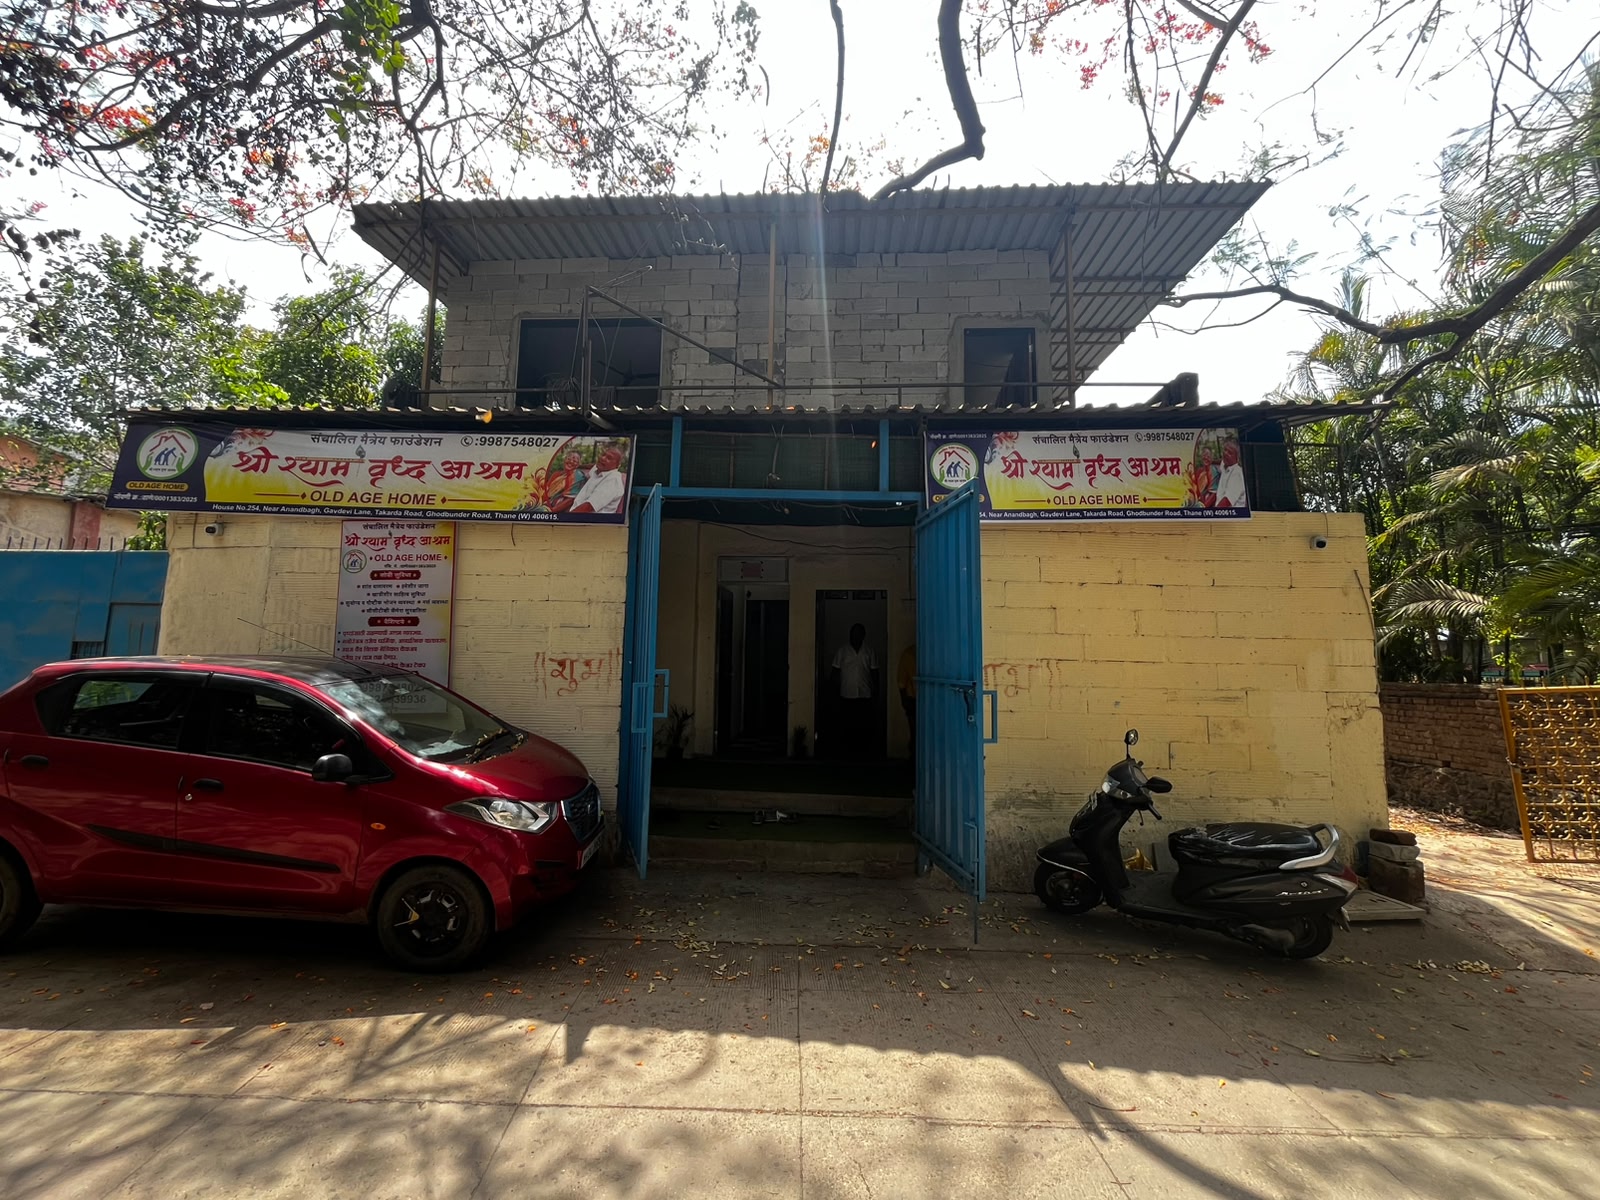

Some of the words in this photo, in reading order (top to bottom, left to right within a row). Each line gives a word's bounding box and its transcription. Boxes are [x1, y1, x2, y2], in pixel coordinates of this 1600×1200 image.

[311, 434, 358, 445] संचालित
[361, 433, 386, 446] मैत्रेय
[390, 434, 443, 447] फाउंडेशन
[1032, 434, 1066, 445] संचालित
[1090, 433, 1129, 444] फाउंडेशन
[310, 490, 344, 503] OLD
[348, 492, 383, 504] AGE
[388, 493, 437, 506] HOME
[1053, 495, 1076, 505] OLD
[1080, 495, 1103, 505] AGE
[1107, 494, 1140, 505] HOME
[280, 506, 322, 515] Anandbagh,
[323, 507, 353, 515] Gavdevi
[354, 508, 373, 516] Lane,
[375, 509, 403, 517] Takarda
[404, 510, 424, 518] Road,
[425, 510, 471, 518] Ghodbunder
[471, 511, 493, 519] Road,
[517, 512, 531, 521] (W)
[1003, 511, 1039, 519] Anandbagh,
[375, 554, 393, 562] OLD
[416, 553, 442, 561] HOME
